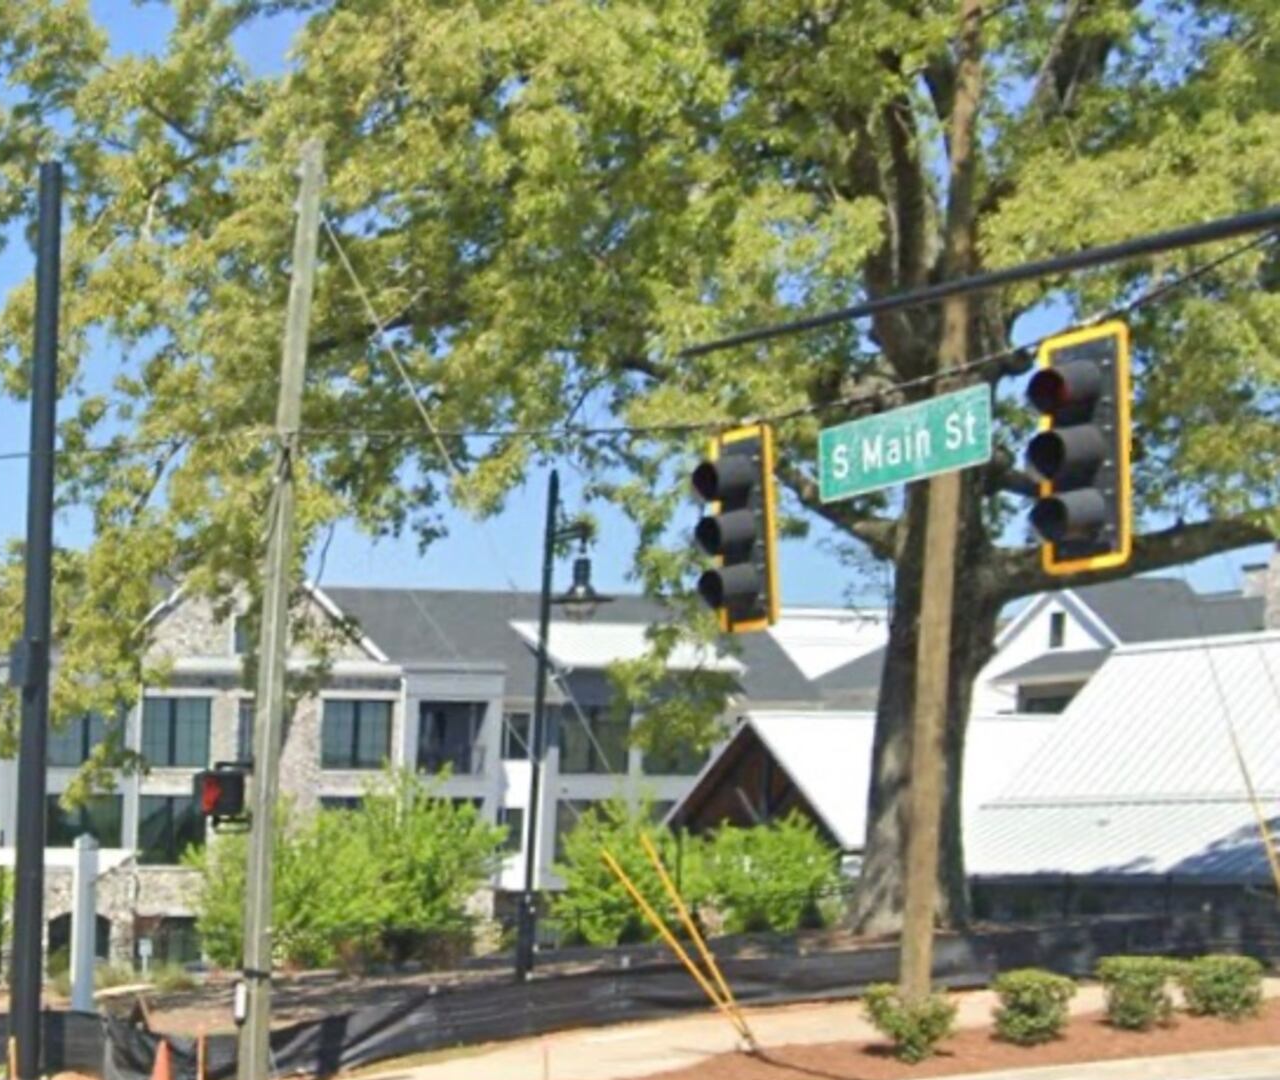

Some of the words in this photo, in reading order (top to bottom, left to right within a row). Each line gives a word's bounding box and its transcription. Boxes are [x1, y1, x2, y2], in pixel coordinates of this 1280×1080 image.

[832, 444, 849, 479] S
[862, 427, 931, 473] Main
[944, 411, 977, 450] St
